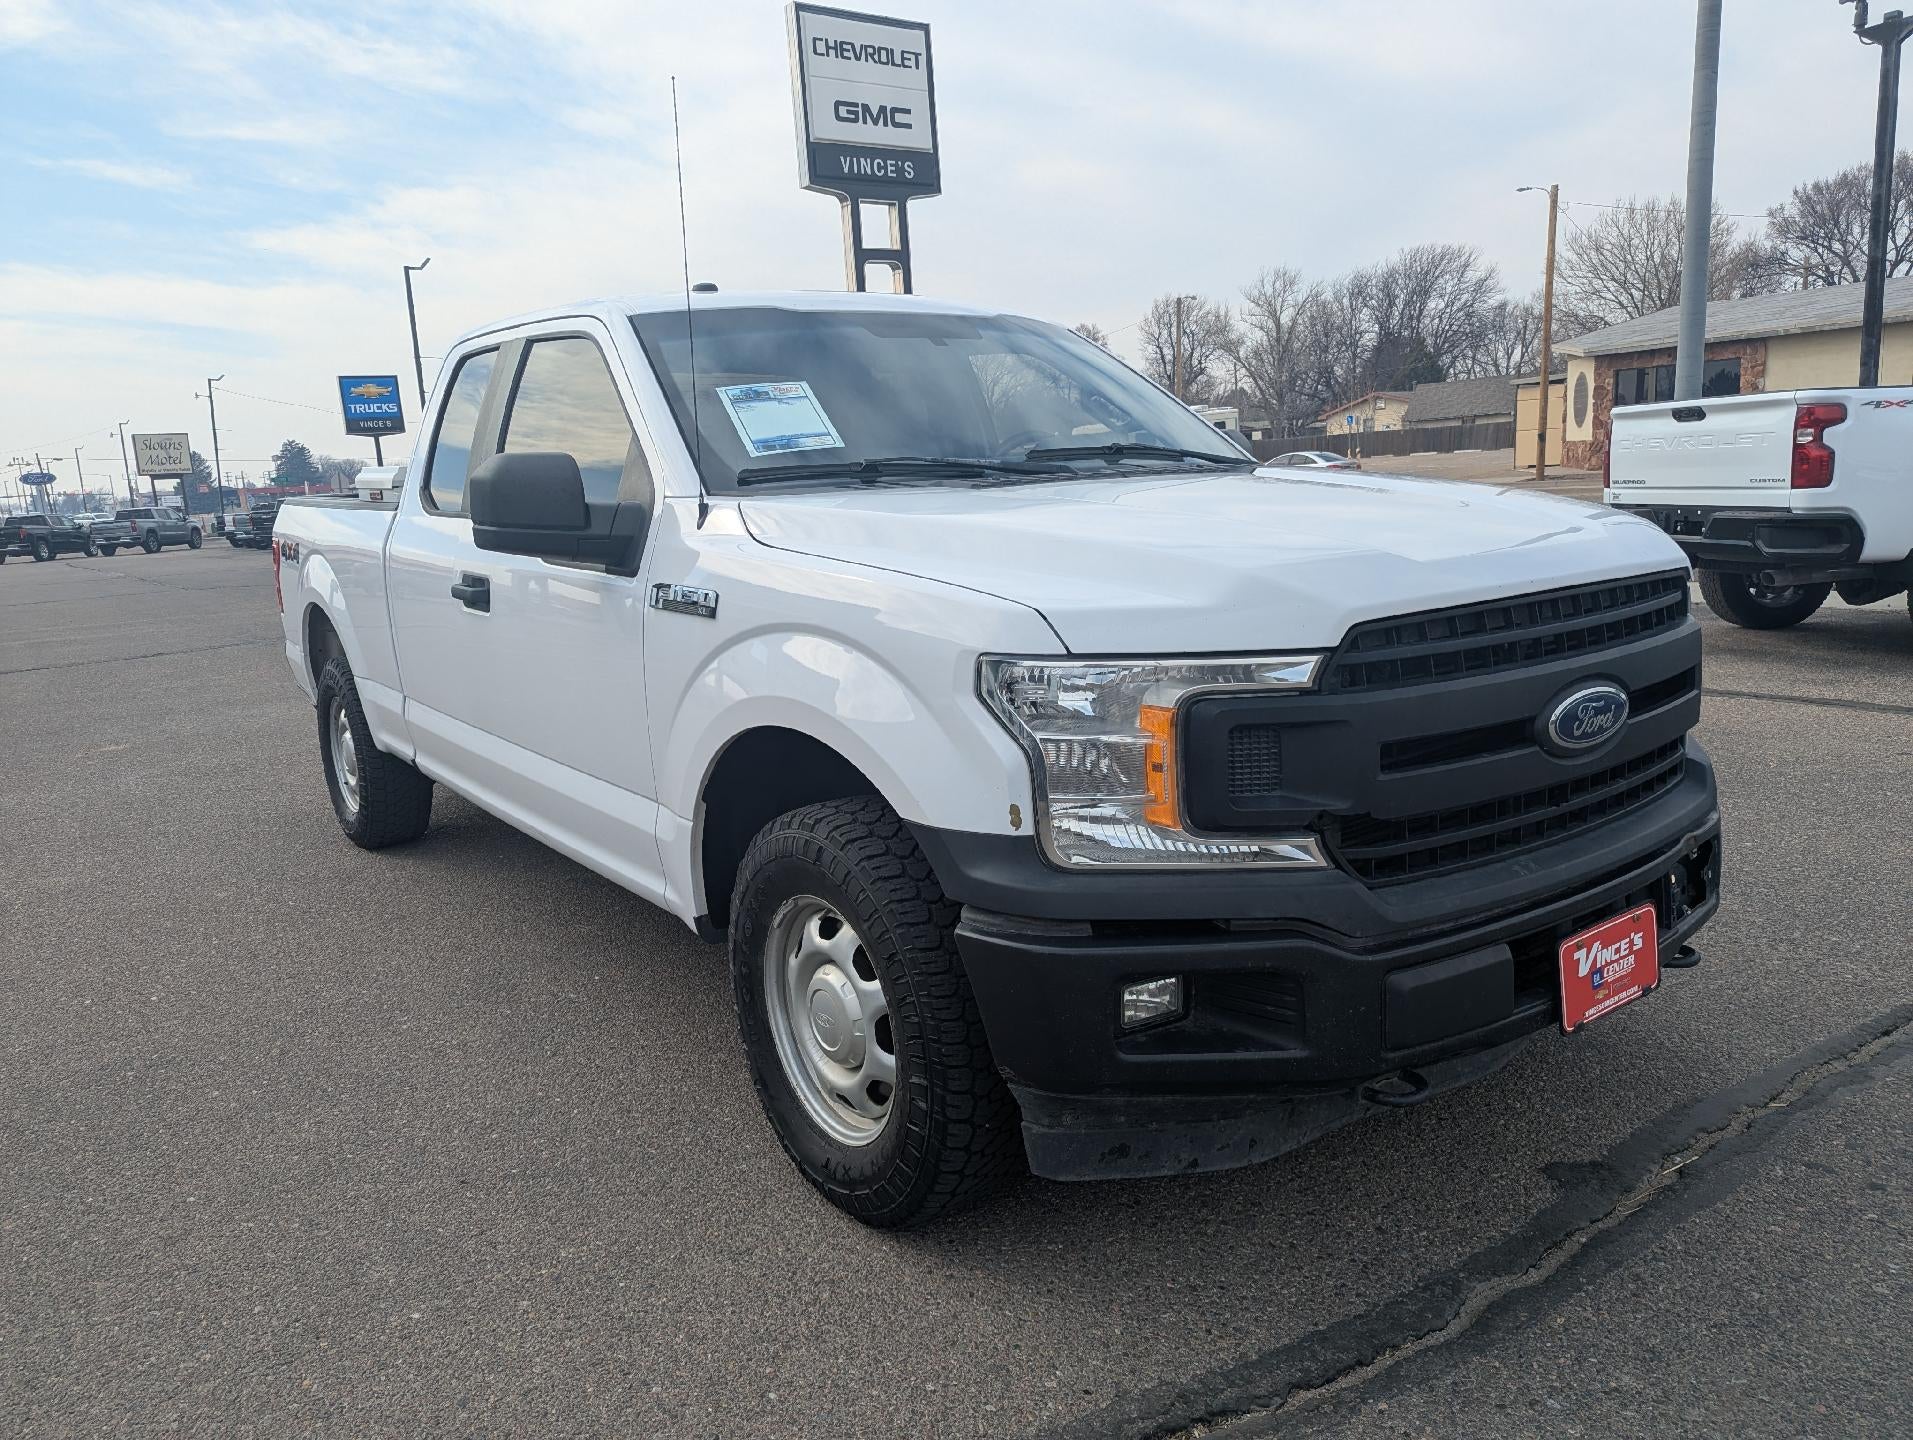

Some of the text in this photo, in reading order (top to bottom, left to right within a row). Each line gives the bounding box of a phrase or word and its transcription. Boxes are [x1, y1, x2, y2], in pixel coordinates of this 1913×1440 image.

[812, 36, 922, 70] CHEVROLET
[833, 99, 913, 130] GMC
[840, 155, 915, 179] VINCE'S
[348, 403, 398, 414] TRUCKS
[359, 420, 392, 428] VINCE'S
[1618, 431, 1777, 453] CHEVROLET
[145, 452, 184, 466] Motel
[1573, 700, 1615, 736] Ford
[1603, 954, 1635, 978] CENTER
